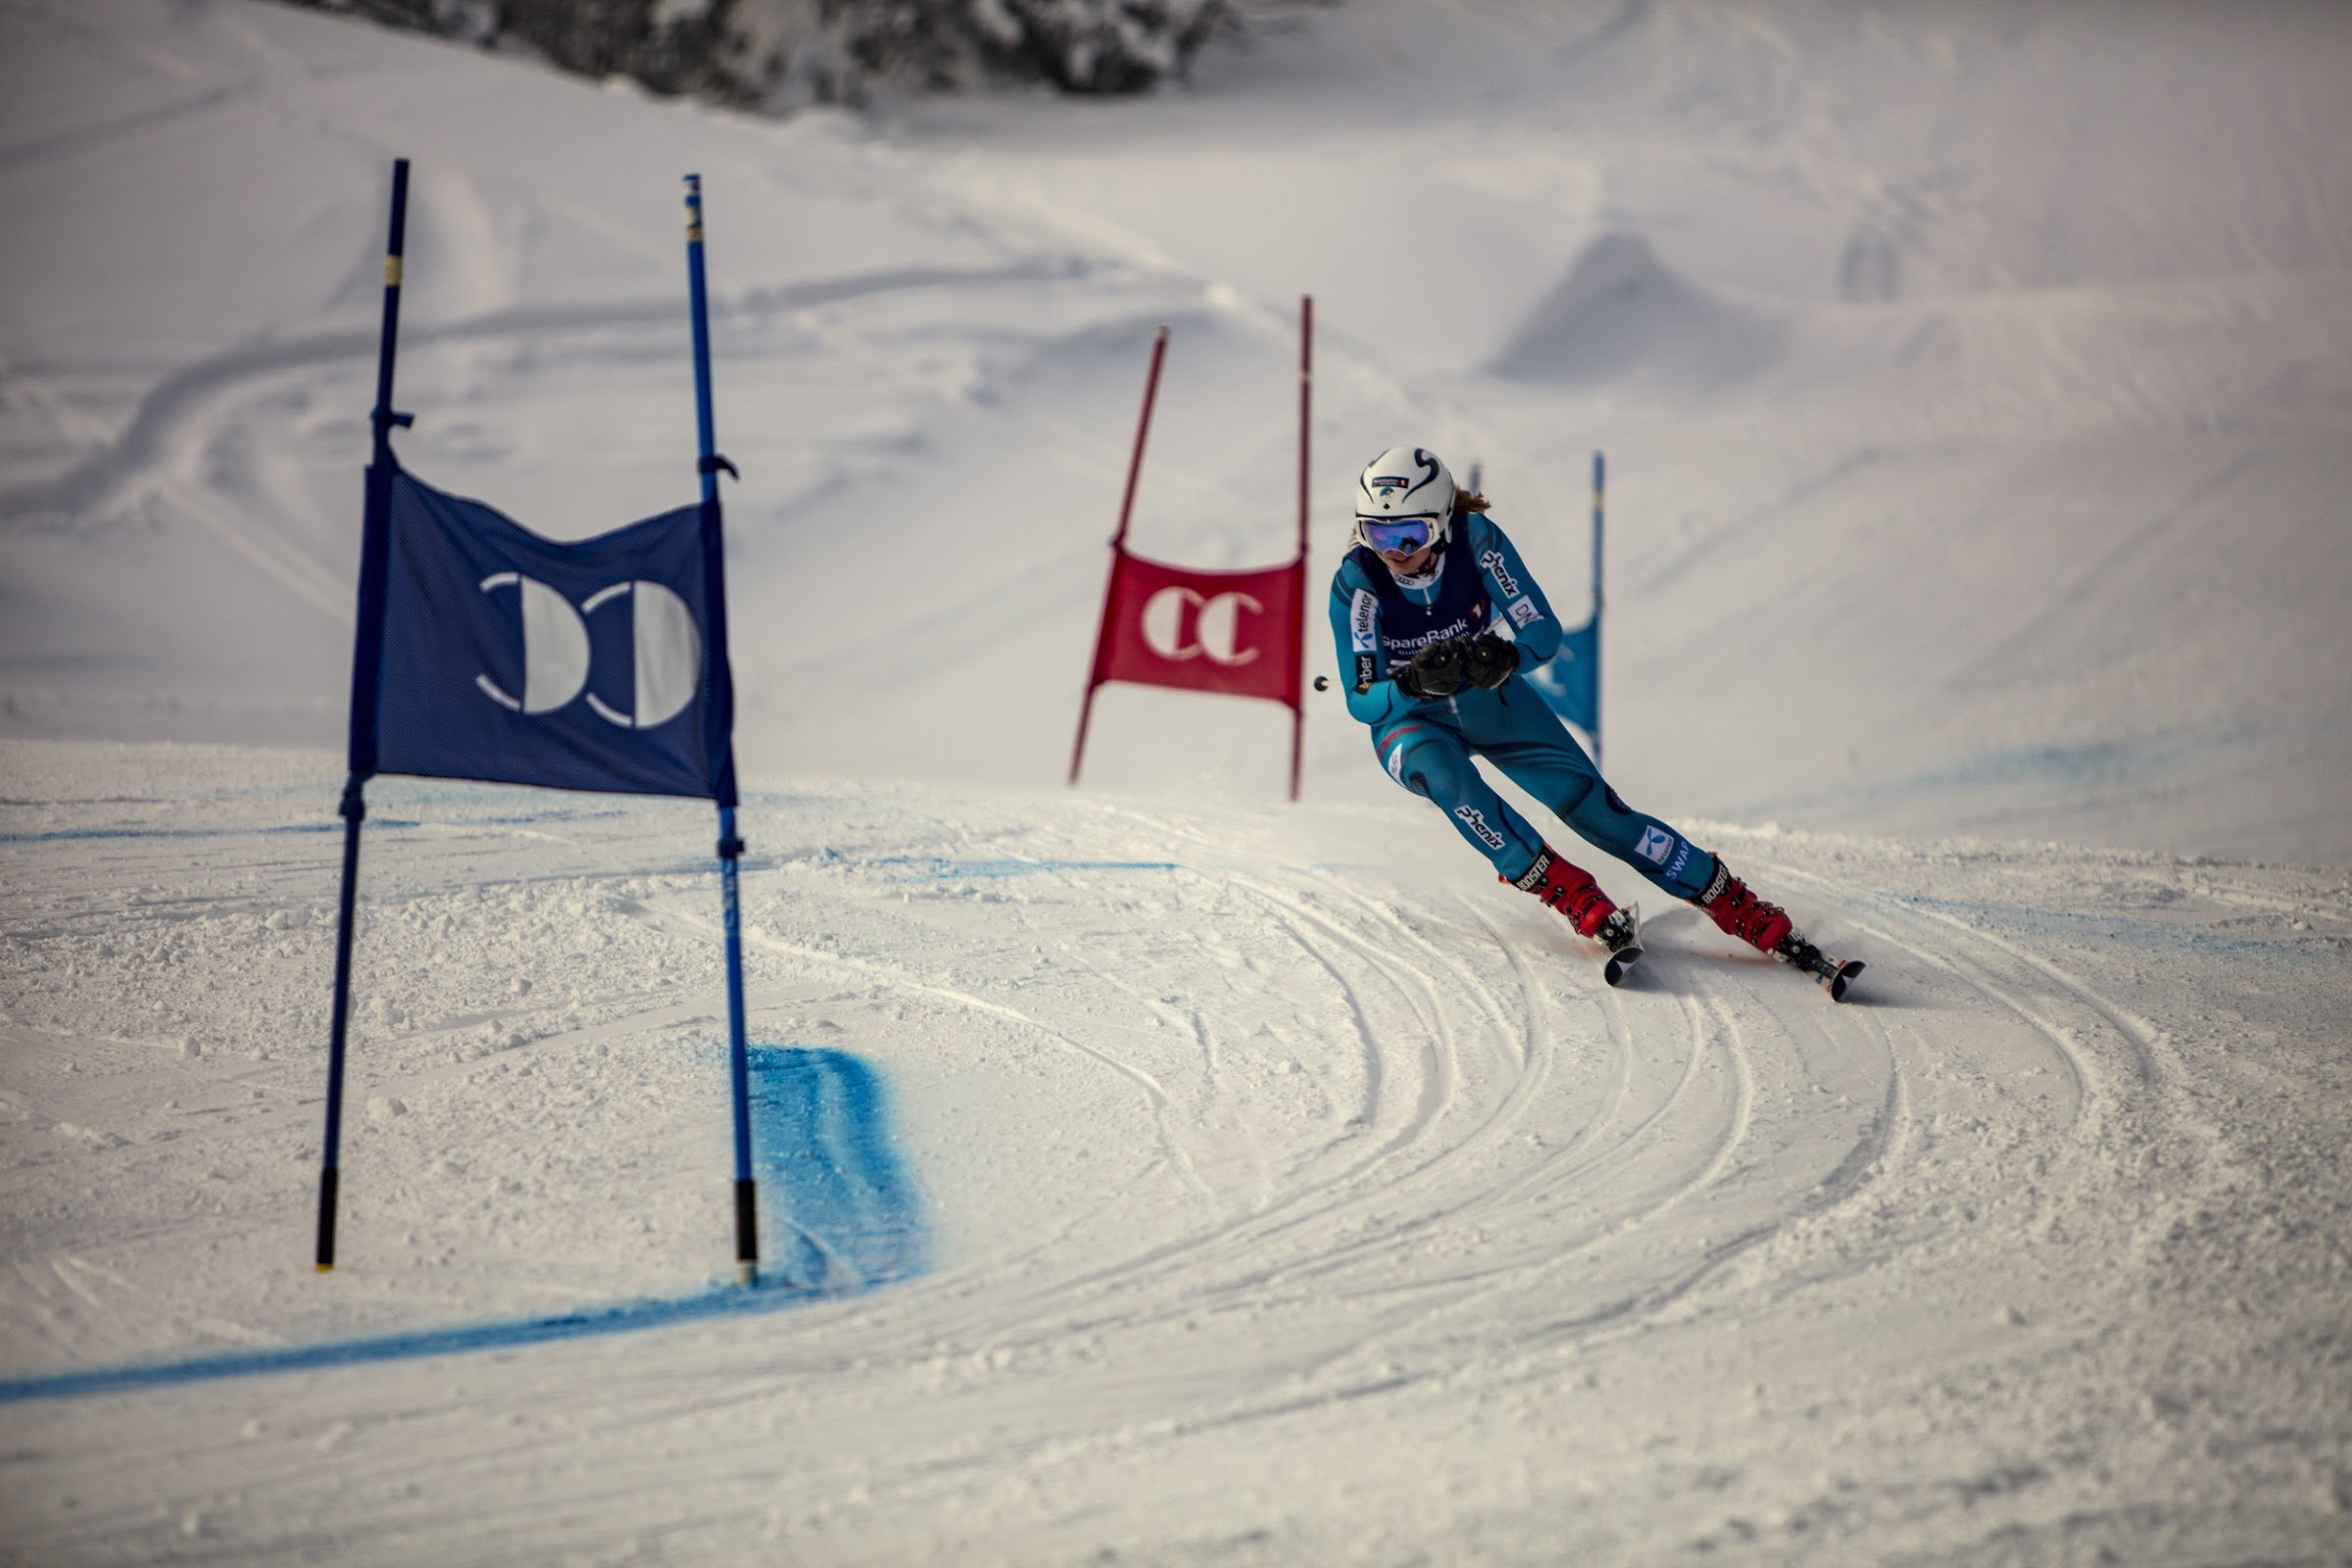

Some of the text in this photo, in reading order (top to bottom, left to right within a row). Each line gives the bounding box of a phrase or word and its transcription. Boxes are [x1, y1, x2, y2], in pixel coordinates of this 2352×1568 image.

[1481, 552, 1517, 597] phenix
[1356, 593, 1373, 633] telenor
[1383, 618, 1468, 650] SpareBank
[1456, 807, 1503, 849] phenix
[1516, 854, 1550, 891] BOOSTER
